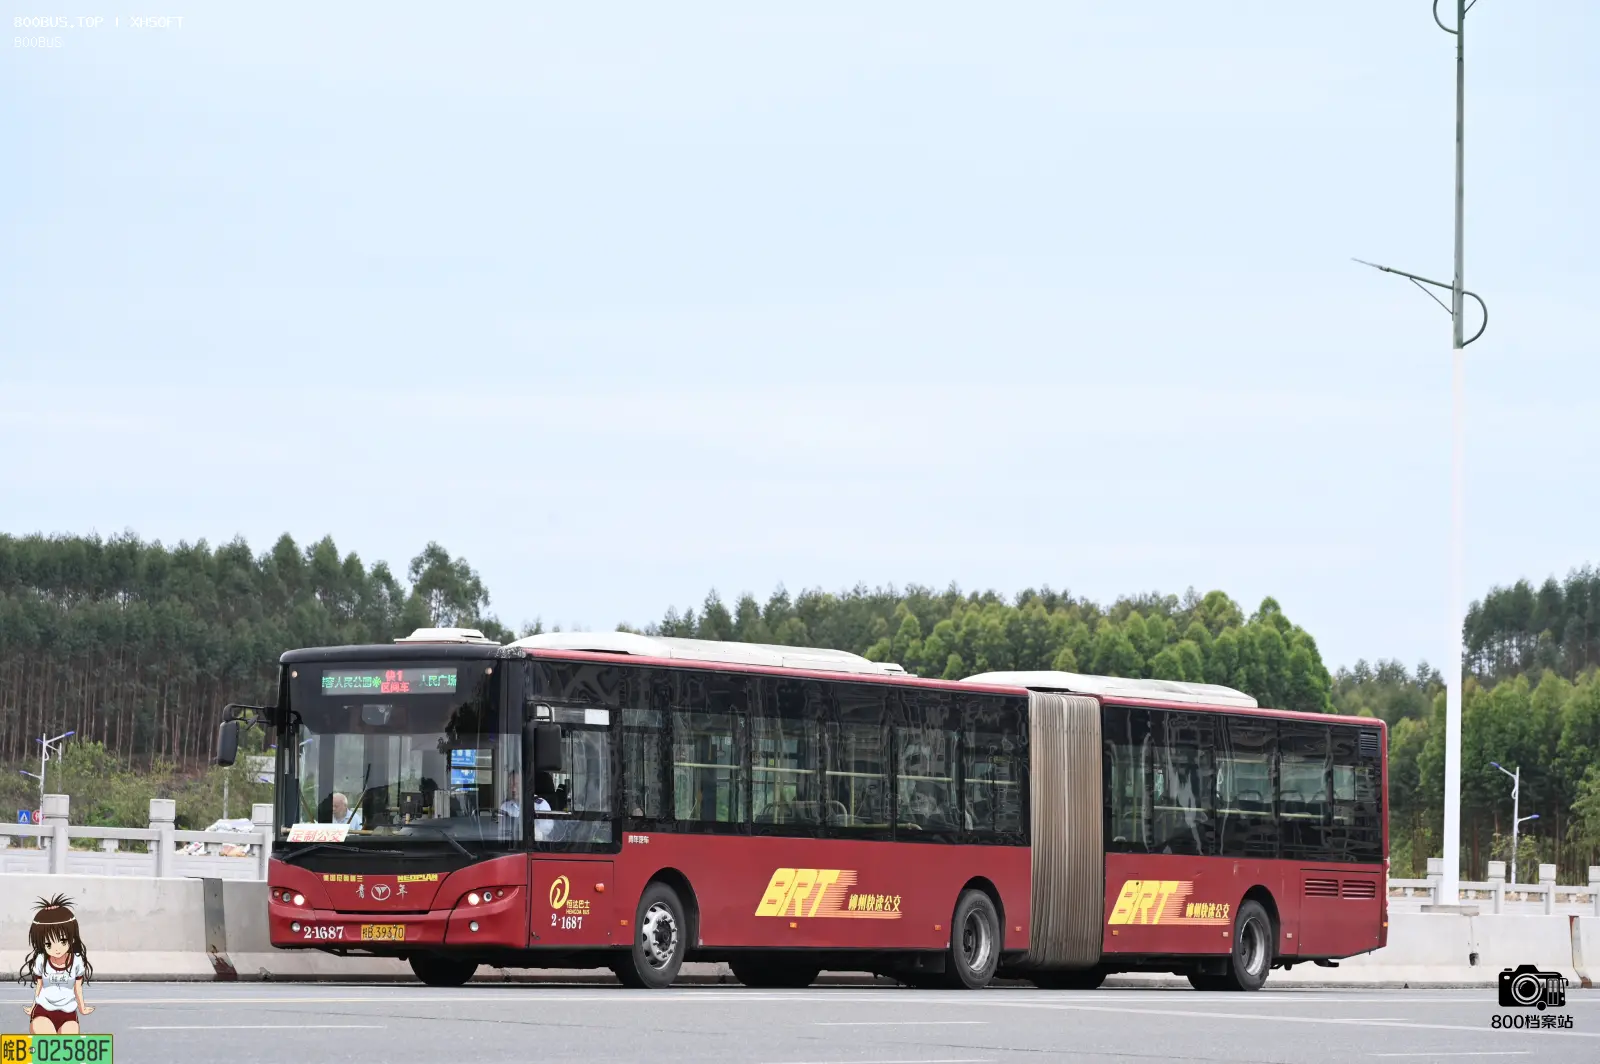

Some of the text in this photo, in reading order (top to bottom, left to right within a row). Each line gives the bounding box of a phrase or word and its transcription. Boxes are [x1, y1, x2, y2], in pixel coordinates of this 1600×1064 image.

[381, 682, 410, 693] 区间车
[290, 829, 345, 843] 定制公交
[397, 873, 438, 882] NEOPLAN
[755, 868, 840, 917] BRT
[566, 899, 591, 909] 恒达巴士
[848, 893, 902, 911] 柳州快速公交
[1108, 880, 1179, 924] BRT
[1186, 902, 1230, 919] 柳州快速公交
